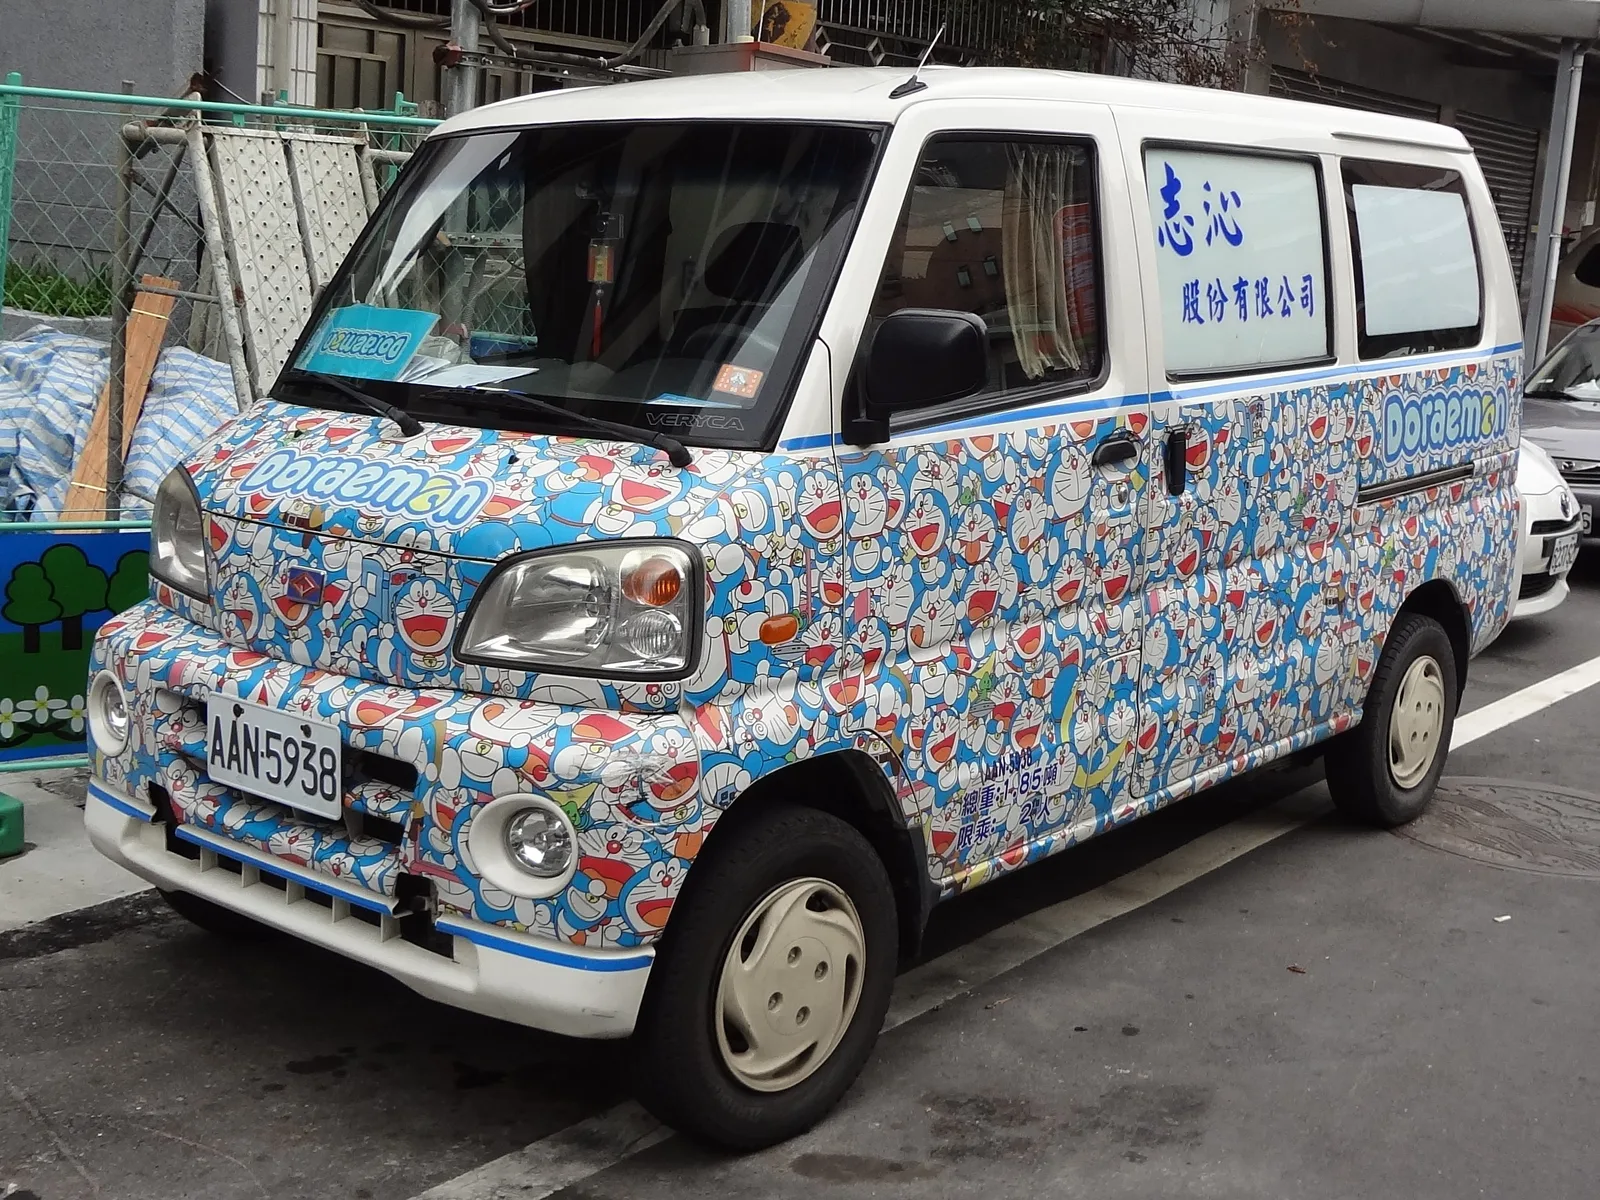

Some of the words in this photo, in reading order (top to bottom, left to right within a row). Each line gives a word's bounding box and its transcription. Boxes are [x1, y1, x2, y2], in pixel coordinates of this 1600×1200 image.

[1182, 274, 1315, 325] 股份有限公司
[645, 412, 745, 431] VERYCA
[1383, 385, 1507, 463] Doraemon
[237, 449, 490, 526] Doraemon
[210, 715, 337, 802] AAN-5938
